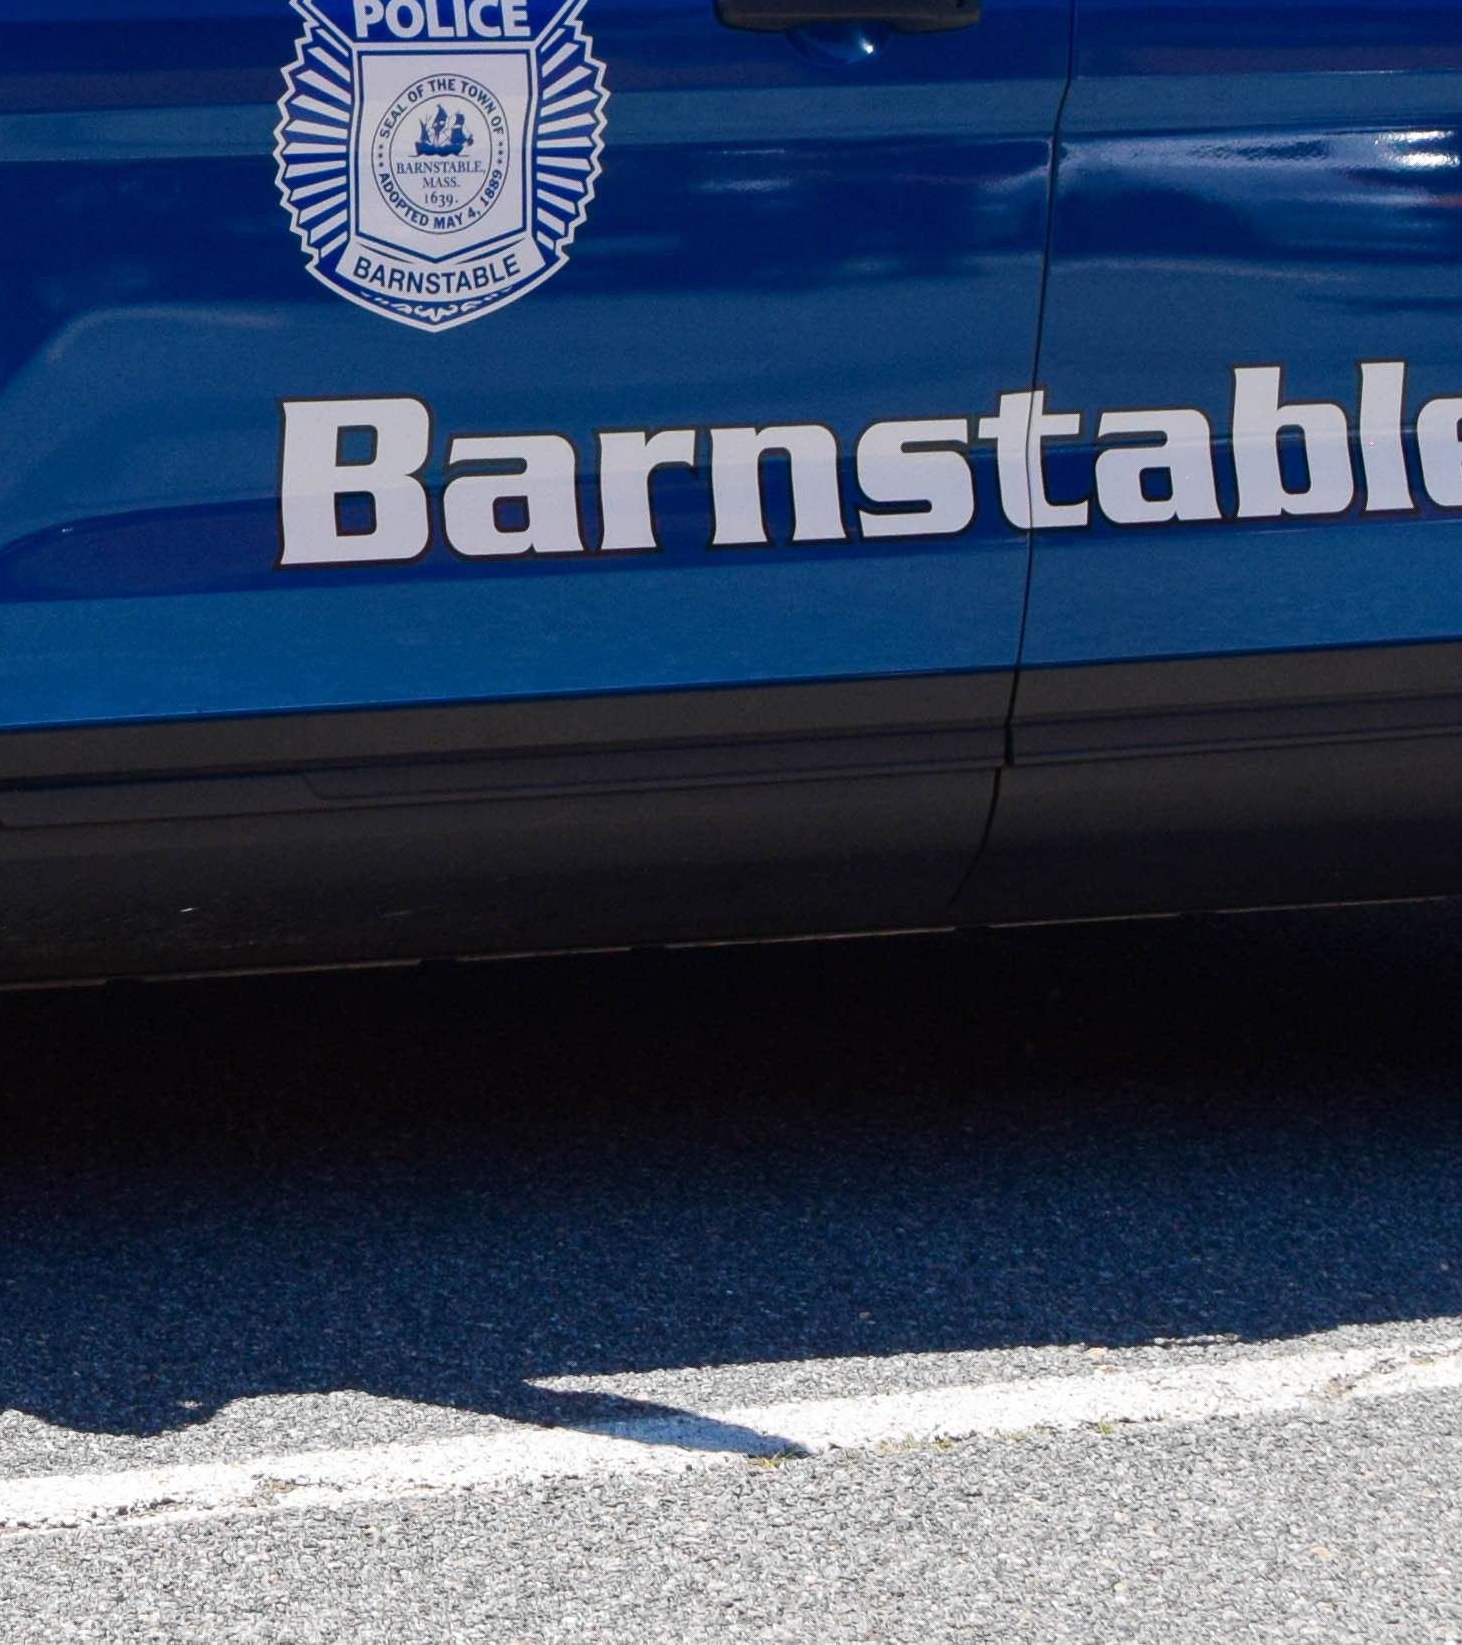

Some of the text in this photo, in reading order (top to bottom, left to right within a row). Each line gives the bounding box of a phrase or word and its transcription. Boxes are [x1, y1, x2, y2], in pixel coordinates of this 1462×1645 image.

[380, 78, 504, 139] SEAL OF THE TOWN OF
[396, 160, 486, 175] BARNSTABLE,
[422, 177, 461, 188] MASS.
[379, 169, 503, 229] ADOPTED MAY 4, 1889
[425, 192, 459, 208] 1639.
[353, 253, 521, 295] BARNSTABLE
